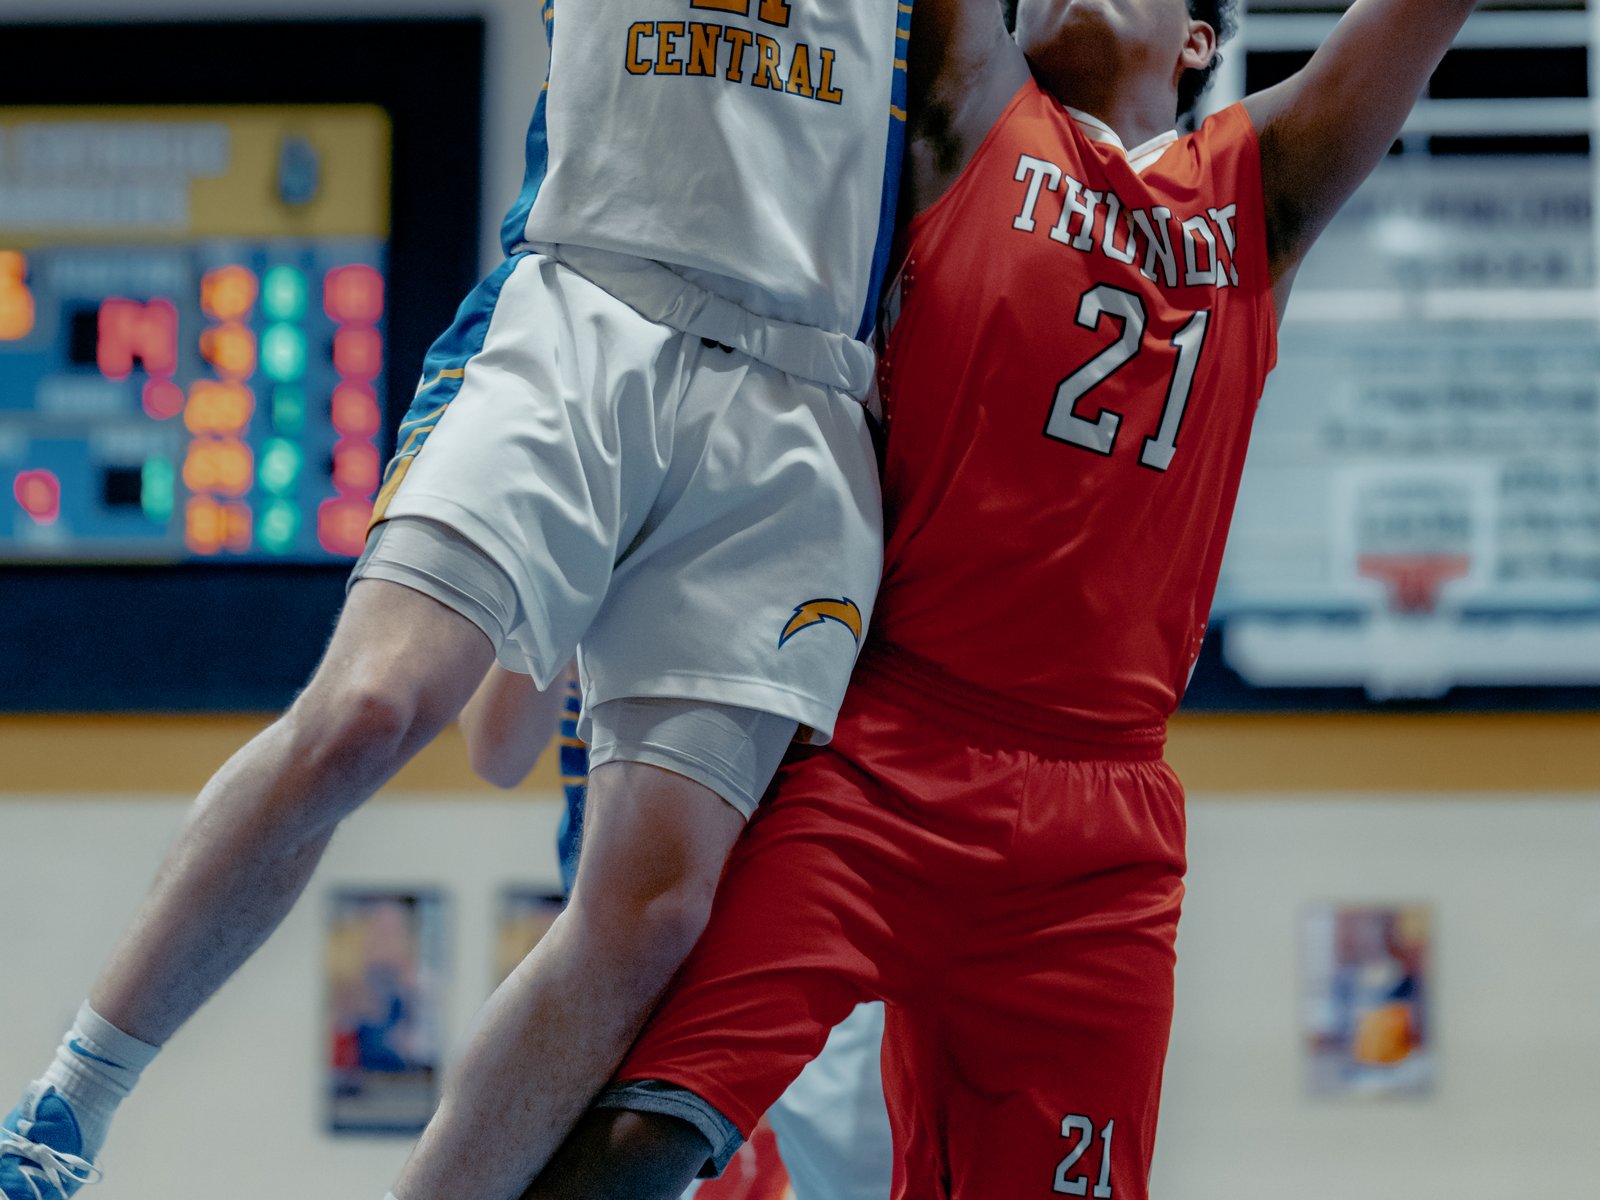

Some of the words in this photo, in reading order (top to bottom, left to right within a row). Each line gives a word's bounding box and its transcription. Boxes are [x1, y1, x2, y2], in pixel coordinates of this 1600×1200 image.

[625, 21, 843, 104] CENTRAL
[1042, 282, 1211, 473] 21
[1052, 1113, 1115, 1199] 21
